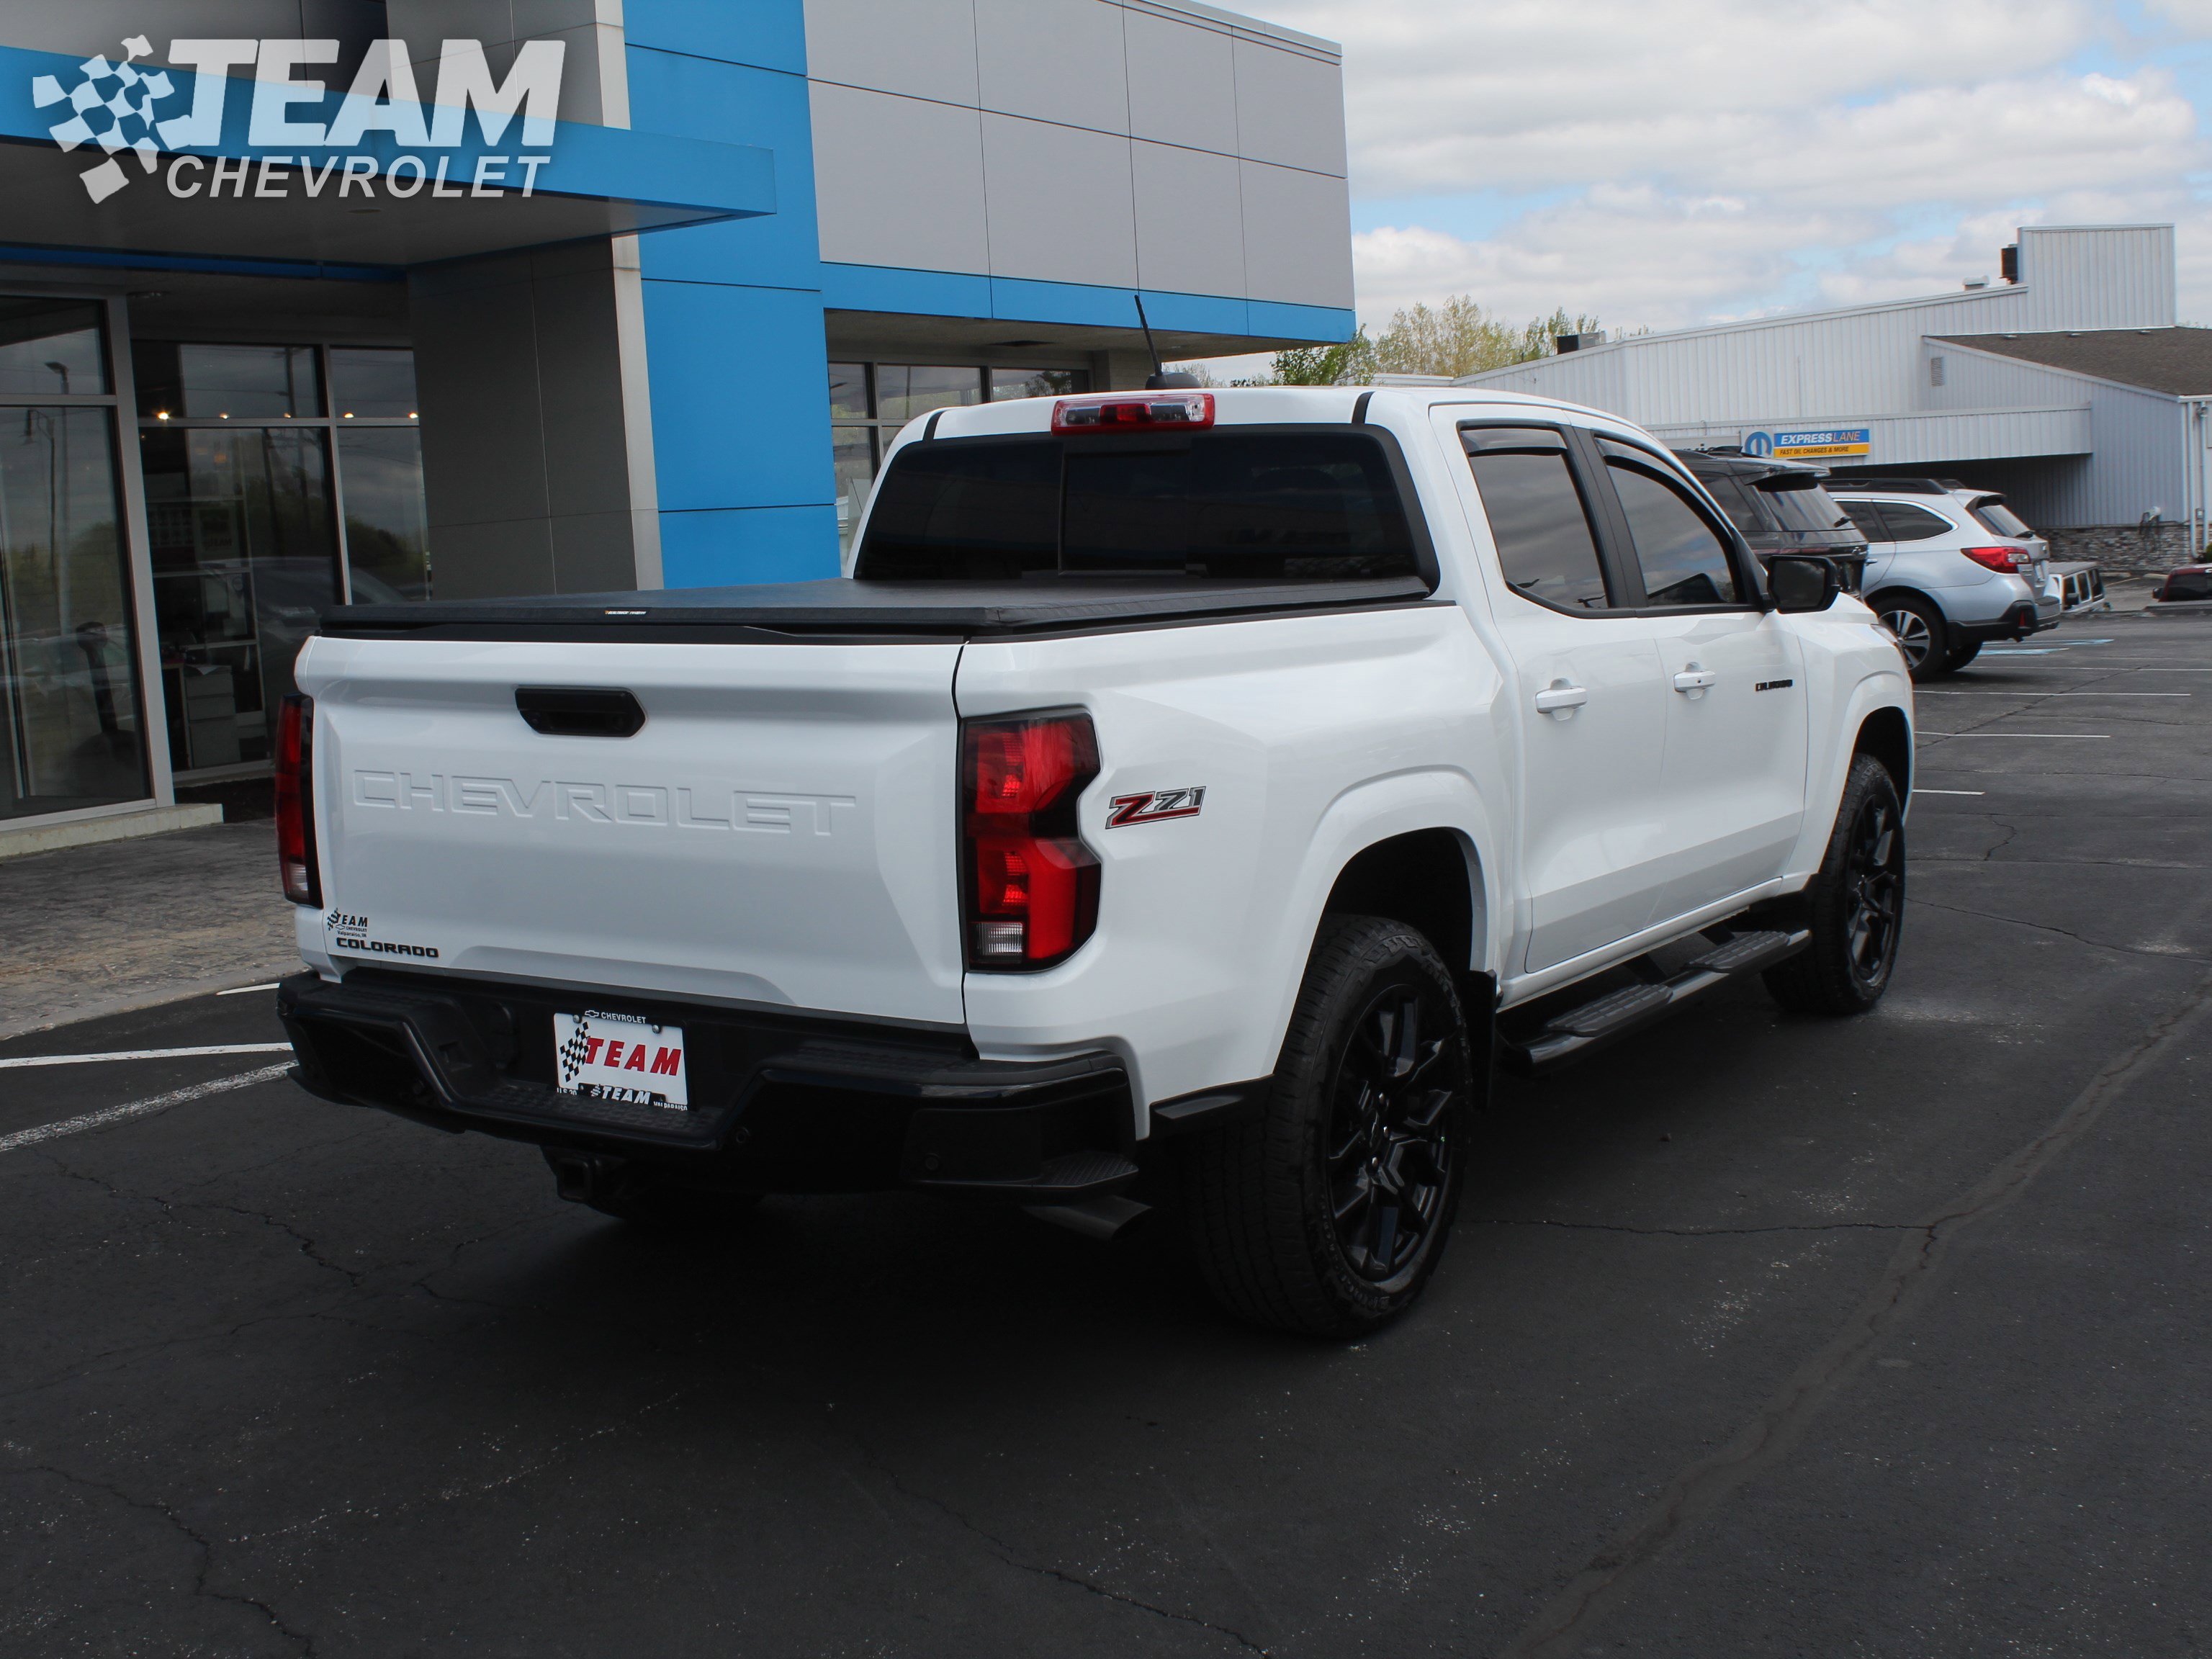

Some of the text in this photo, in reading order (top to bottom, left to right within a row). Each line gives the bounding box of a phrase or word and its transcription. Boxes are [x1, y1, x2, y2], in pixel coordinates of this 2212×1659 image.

[354, 769, 857, 836] CHEVROLET
[1105, 786, 1206, 830] Z71
[335, 914, 367, 927] TEAM
[336, 937, 439, 958] COLORADO
[601, 1012, 646, 1024] CHEVROLET
[585, 1037, 681, 1076] TEAM
[602, 1085, 651, 1105] TEAM
